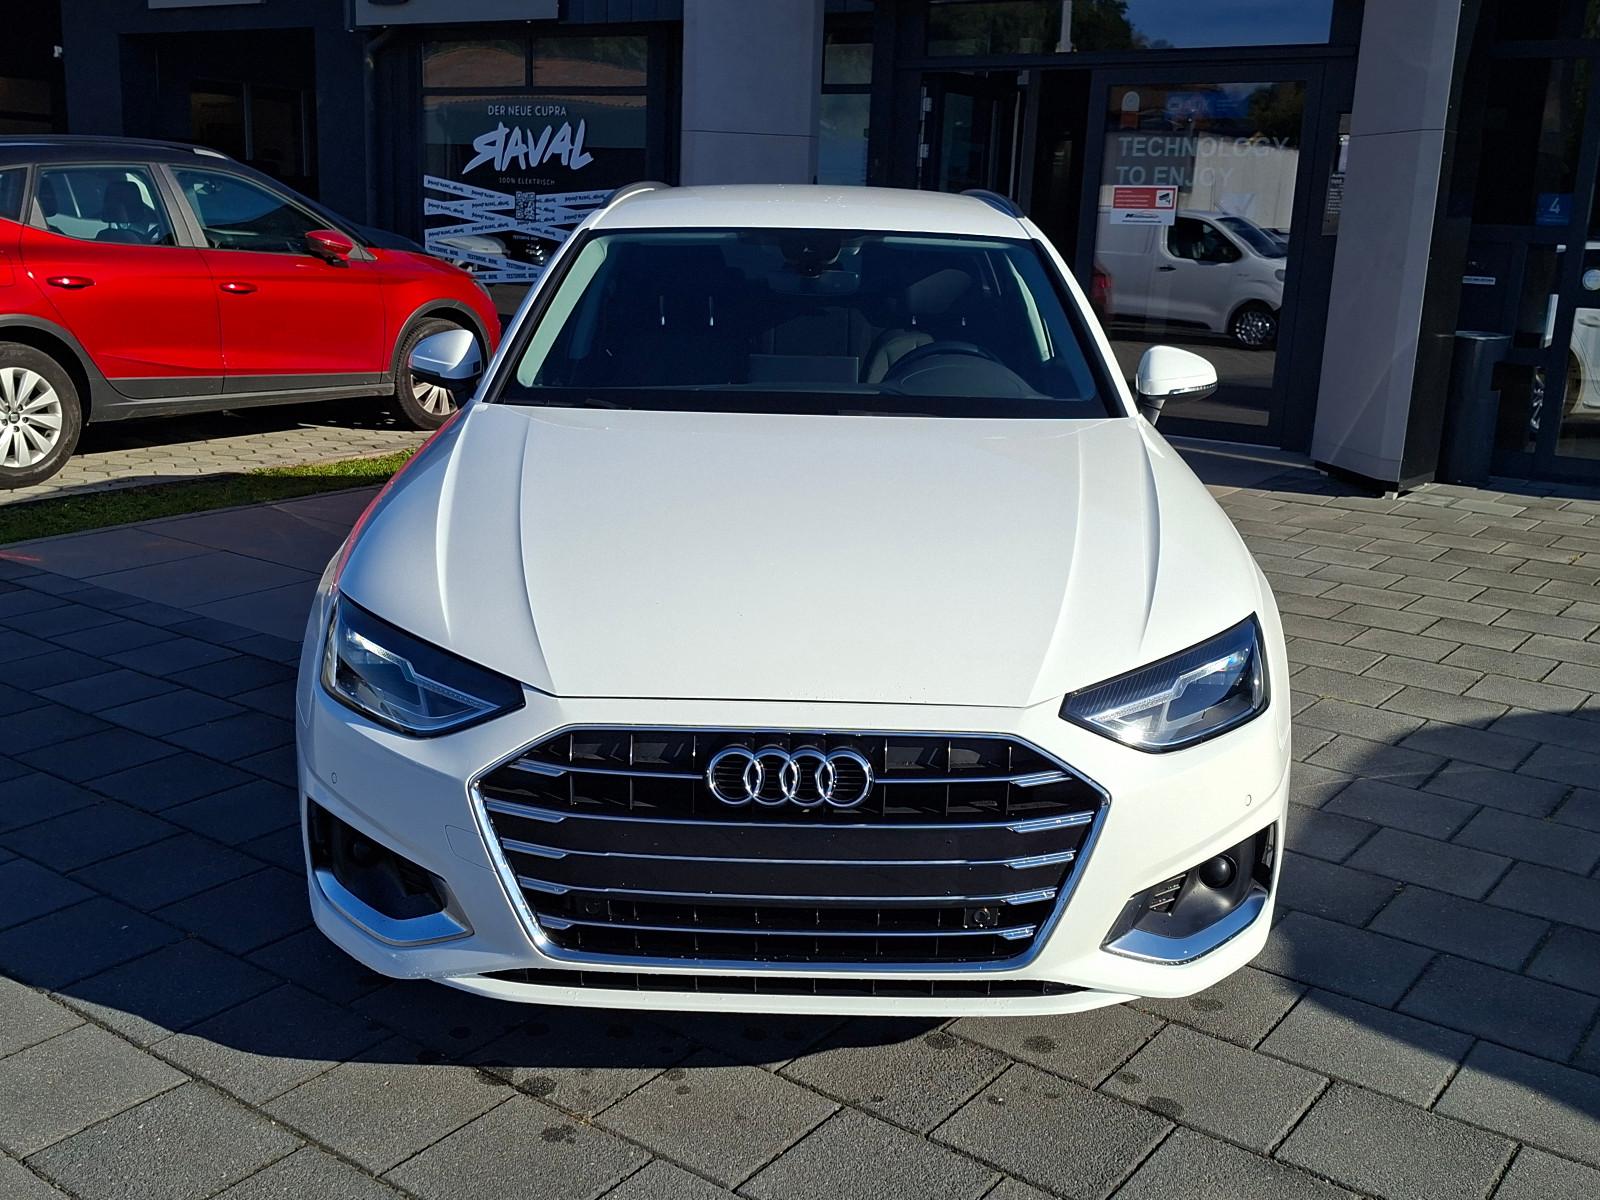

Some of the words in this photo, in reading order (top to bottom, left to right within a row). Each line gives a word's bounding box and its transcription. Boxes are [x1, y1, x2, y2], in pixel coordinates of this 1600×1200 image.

[487, 104, 506, 117] DER
[508, 105, 533, 117] NEUE
[535, 105, 567, 117] CUPRA
[462, 118, 594, 175] RAVAL
[1117, 136, 1290, 158] TECHNOLOGY
[517, 177, 556, 187] ELEKTRISCH
[1115, 166, 1146, 186] TO
[1153, 166, 1236, 187] ENJOY
[1549, 197, 1561, 214] 4
